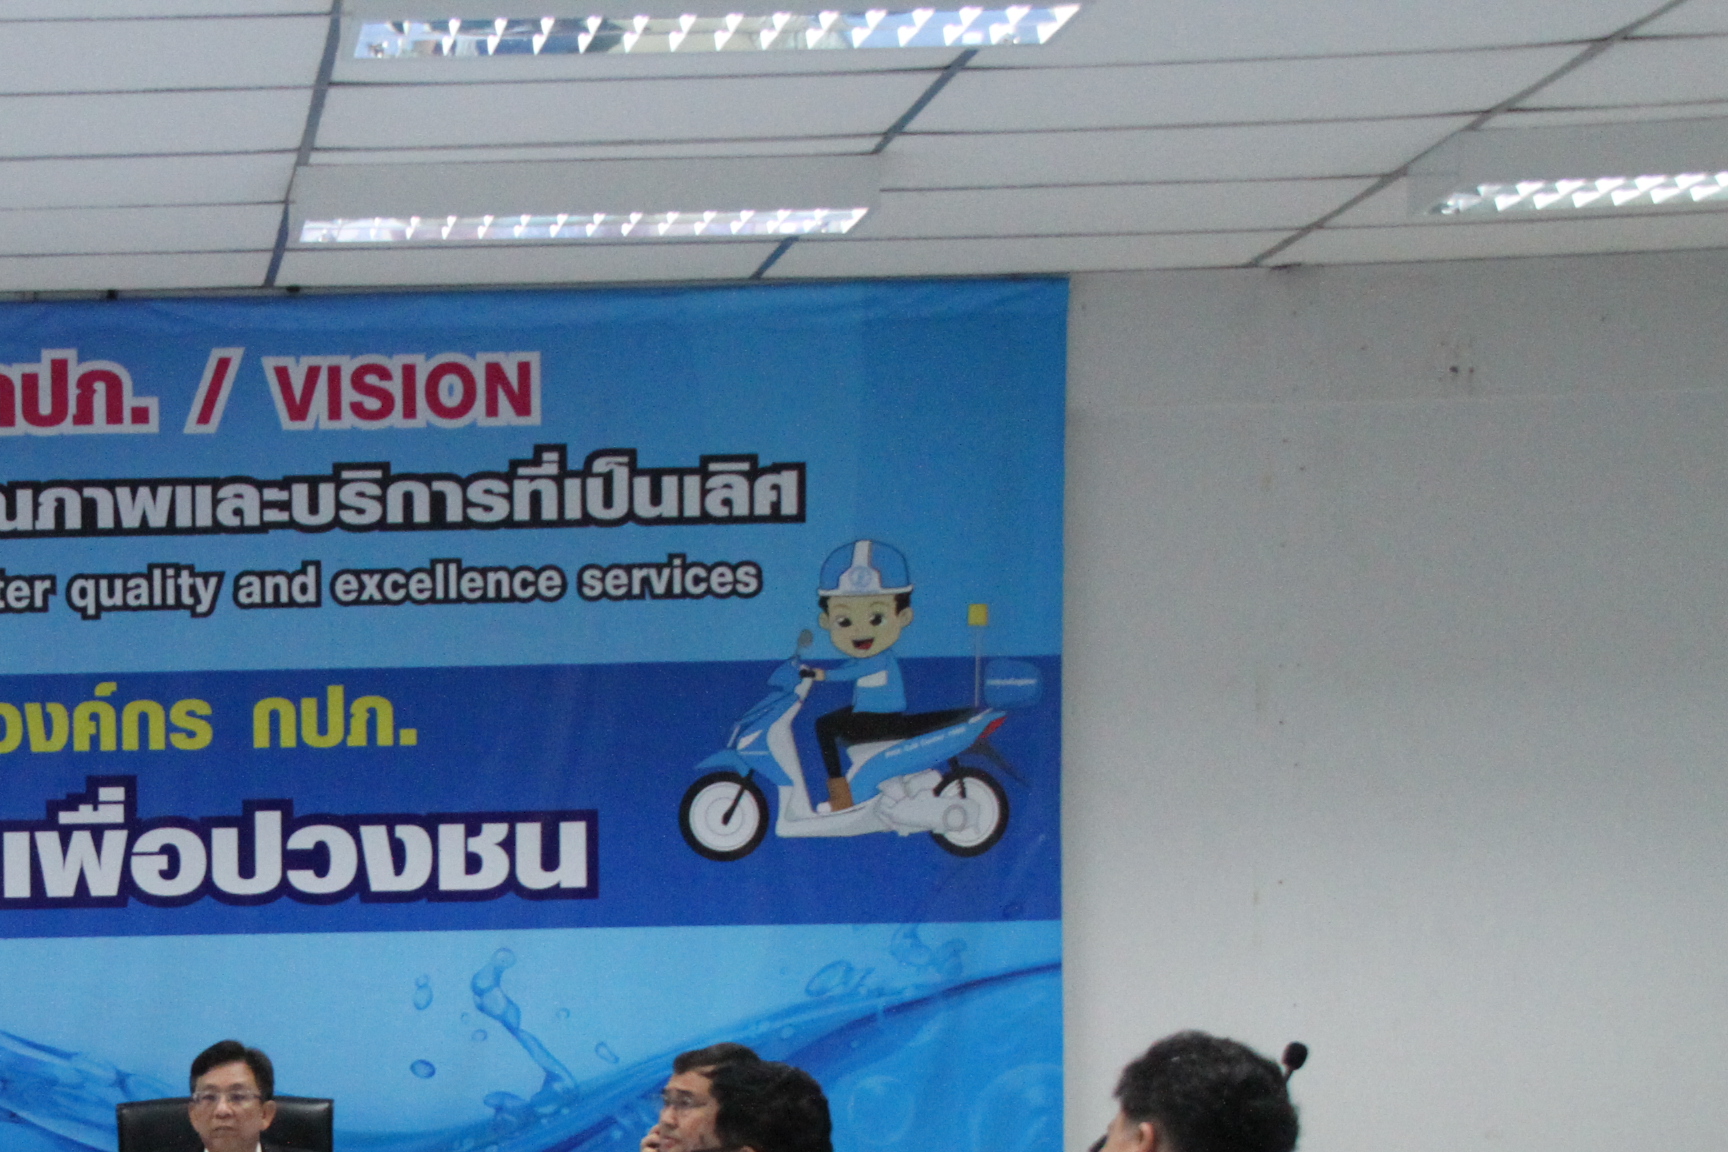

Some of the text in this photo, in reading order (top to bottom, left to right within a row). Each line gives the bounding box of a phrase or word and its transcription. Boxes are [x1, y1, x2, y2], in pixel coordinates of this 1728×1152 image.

[194, 355, 234, 427] /
[272, 359, 533, 424] VISION
[71, 569, 220, 615] quality
[238, 566, 318, 604] and
[335, 564, 563, 602] excellence
[581, 560, 760, 597] services
[252, 683, 419, 749] กปภ.
